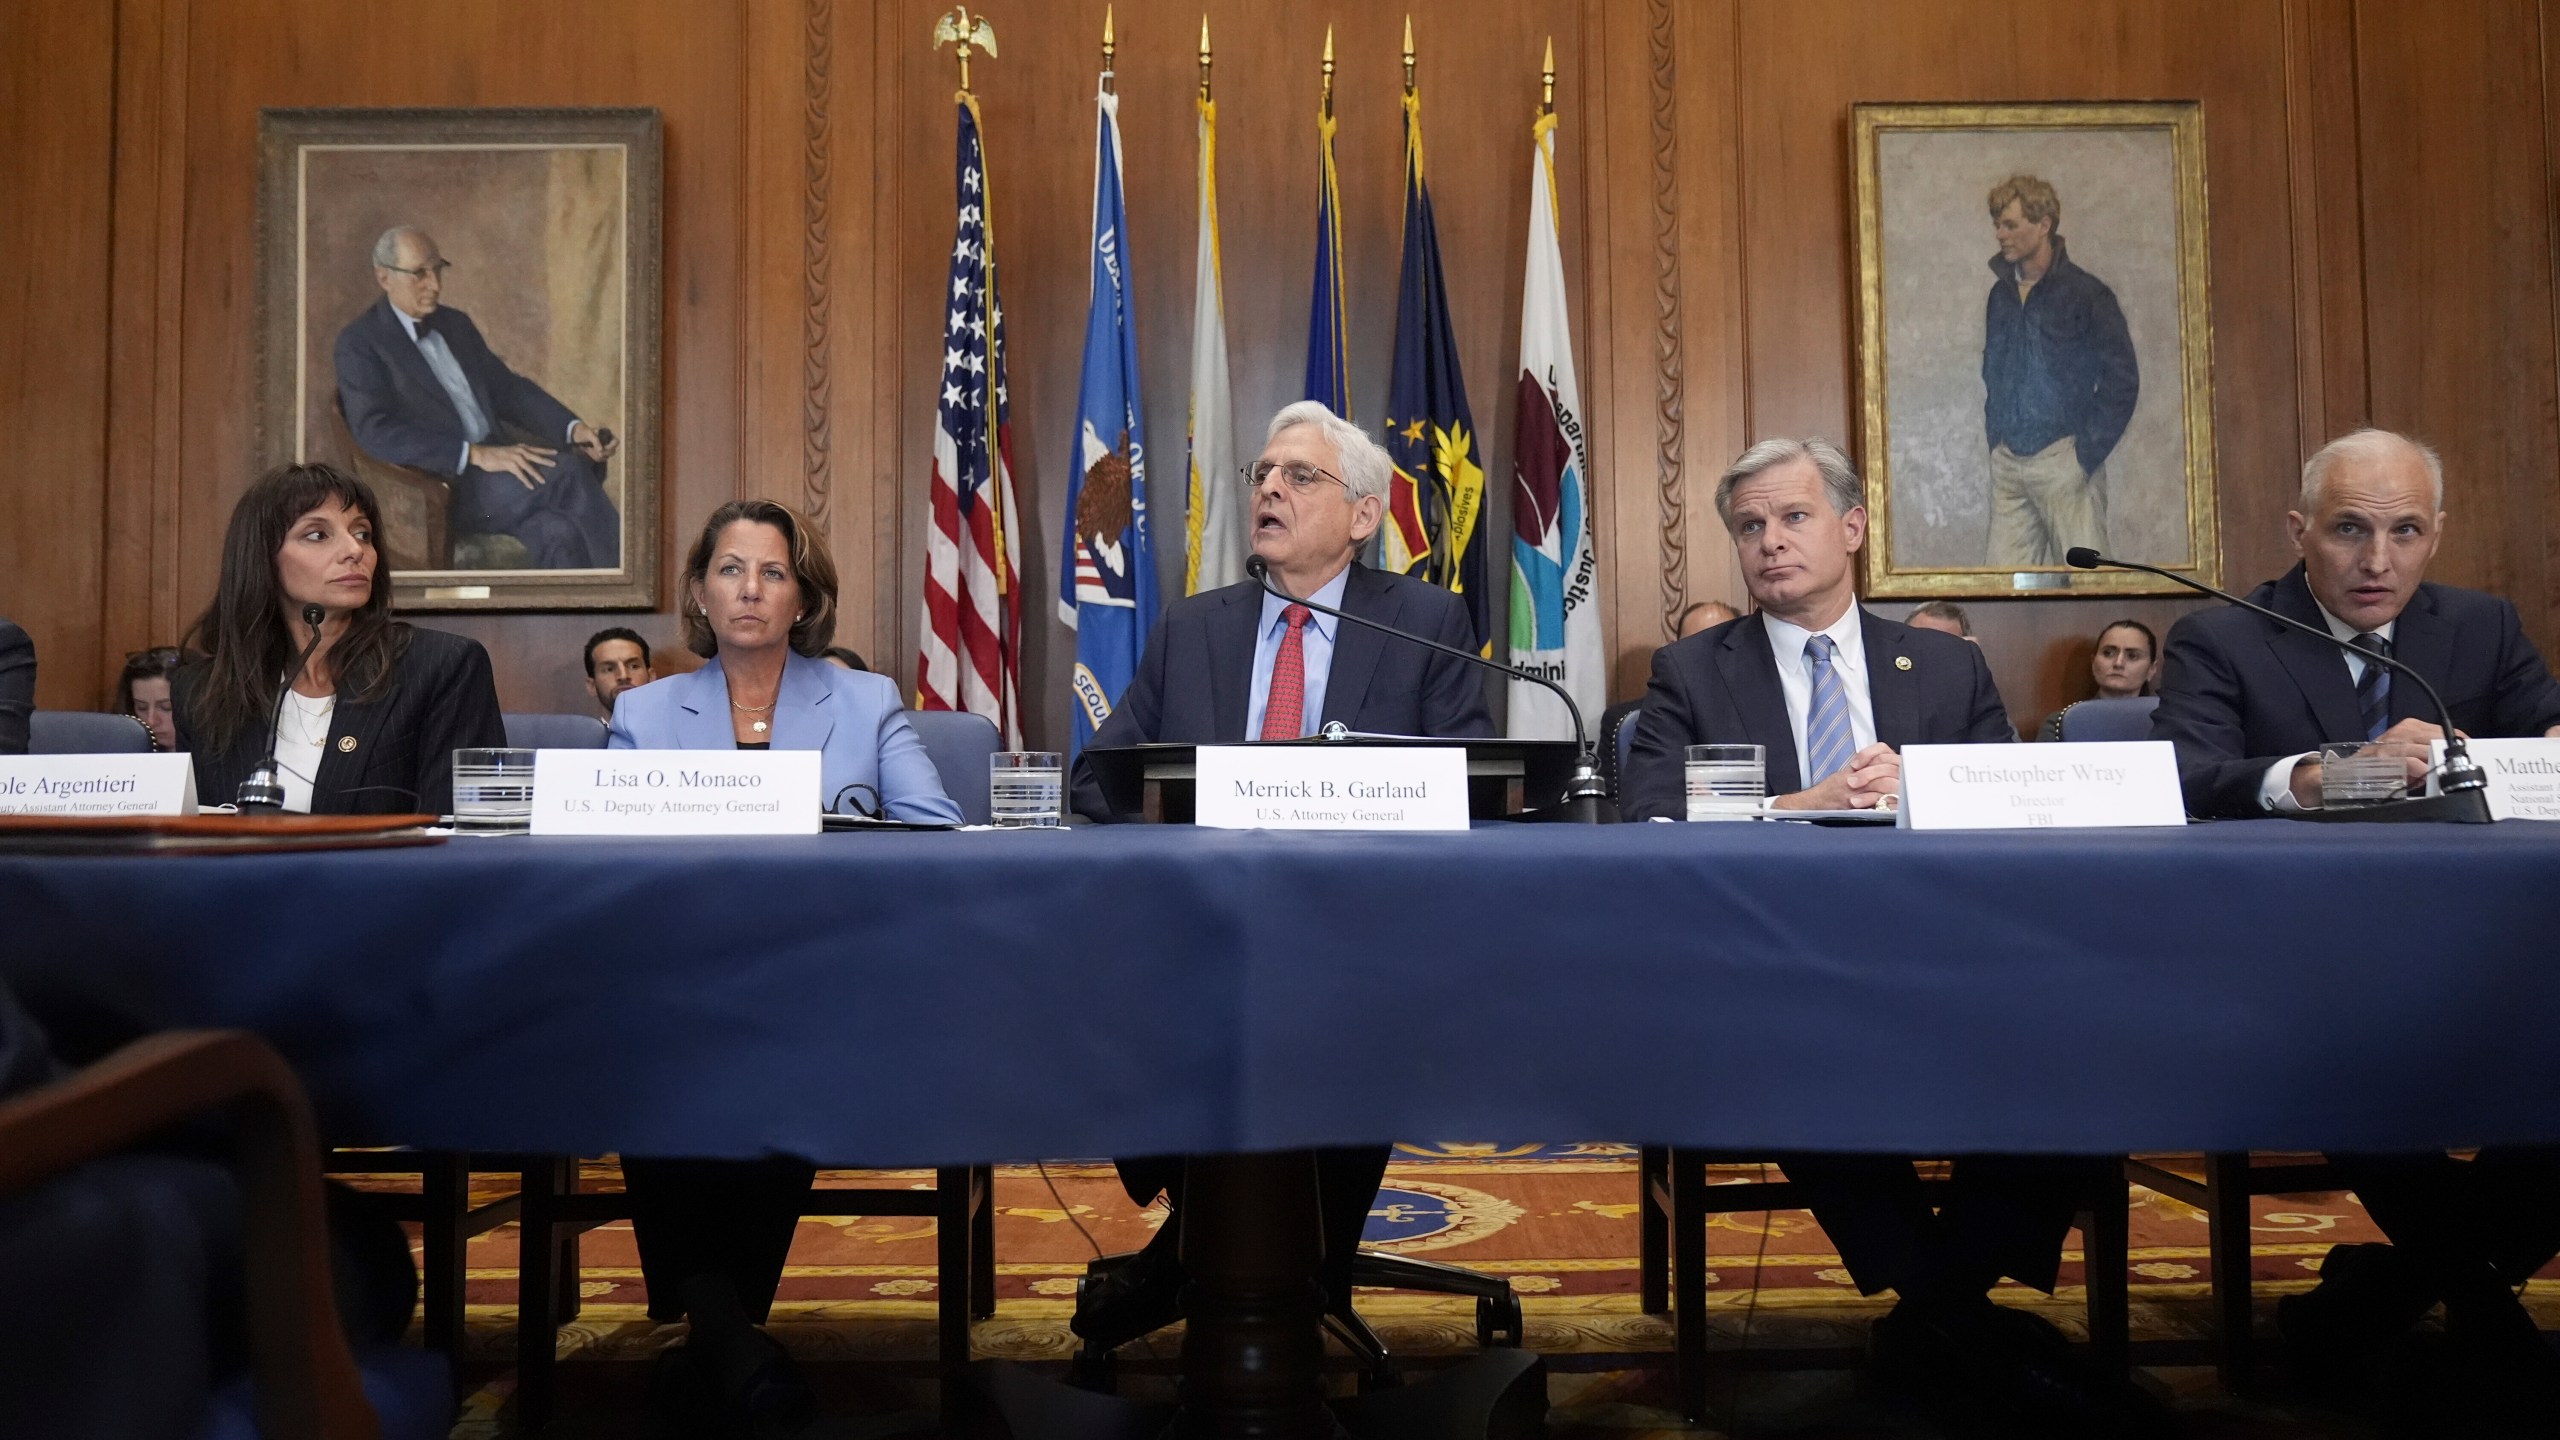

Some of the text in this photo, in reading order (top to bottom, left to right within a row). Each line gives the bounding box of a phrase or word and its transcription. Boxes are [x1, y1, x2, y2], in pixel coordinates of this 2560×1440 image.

[1453, 486, 1474, 541] plosives
[1076, 674, 1107, 725] SEQU
[595, 769, 762, 788] Lisa O. Monaco
[1949, 764, 2127, 788] Christopher Wray
[33, 774, 136, 799] Argentieri
[1235, 780, 1427, 799] Merrick B. Garland
[20, 803, 67, 813] Assistant
[69, 802, 115, 813] Attorney
[117, 800, 158, 811] General
[564, 800, 780, 817] U.S. Deputy Attorney General
[2010, 794, 2065, 808] Director
[1256, 808, 1404, 824] U.S. Attorney General
[2027, 813, 2055, 826] FBI
